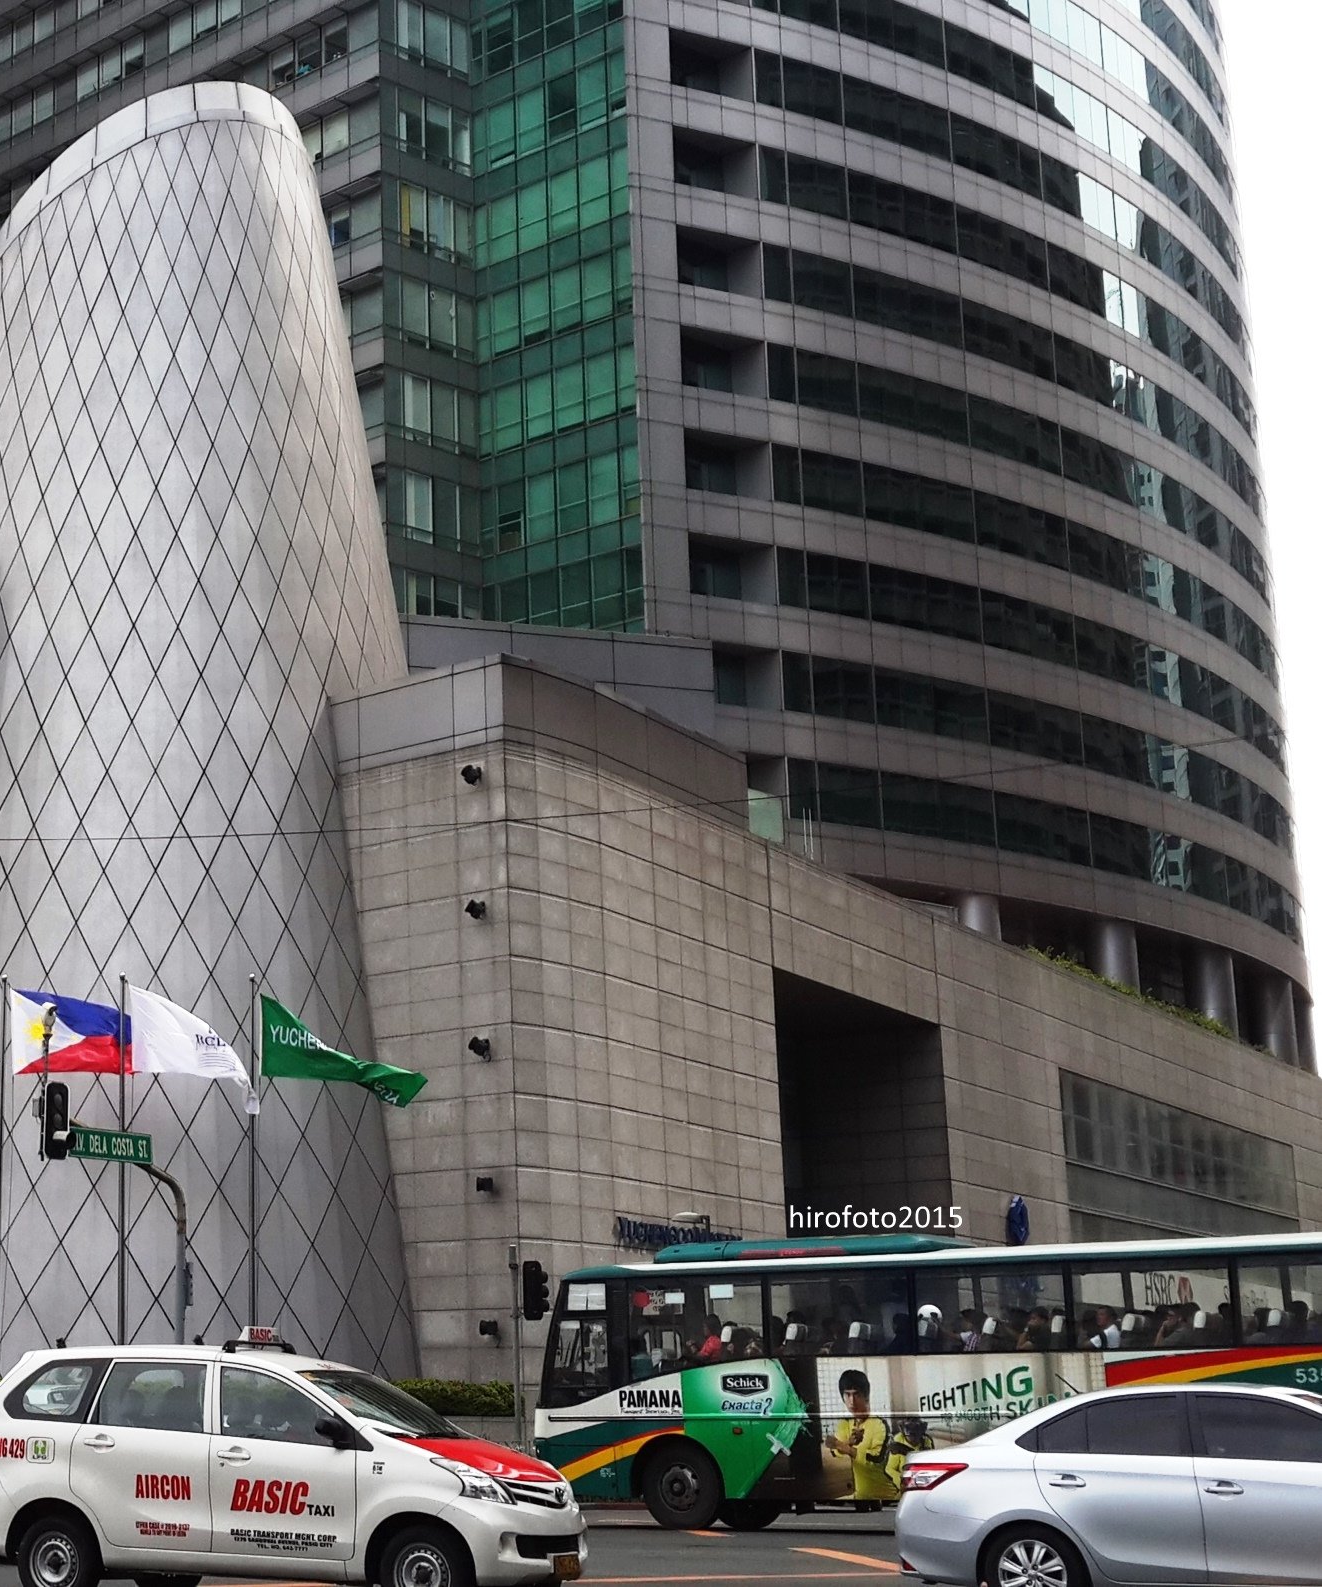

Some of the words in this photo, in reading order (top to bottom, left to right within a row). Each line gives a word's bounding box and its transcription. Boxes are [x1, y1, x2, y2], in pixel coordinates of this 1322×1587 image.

[89, 1134, 108, 1154] DELA
[111, 1137, 135, 1157] COSTA
[138, 1140, 149, 1158] ST.
[1144, 1272, 1176, 1306] HSBC
[250, 1327, 272, 1341] BASIC
[726, 1377, 764, 1390] Schick
[919, 1366, 1034, 1413] FIGHTING
[619, 1389, 682, 1408] PAMANA
[721, 1399, 763, 1411] Exacta
[8, 1438, 26, 1459] 429
[135, 1474, 191, 1500] AIRCON
[230, 1479, 310, 1516] BASIC
[307, 1503, 336, 1517] TAXI
[230, 1528, 252, 1537] BASIC
[253, 1529, 294, 1540] TRANSPORT
